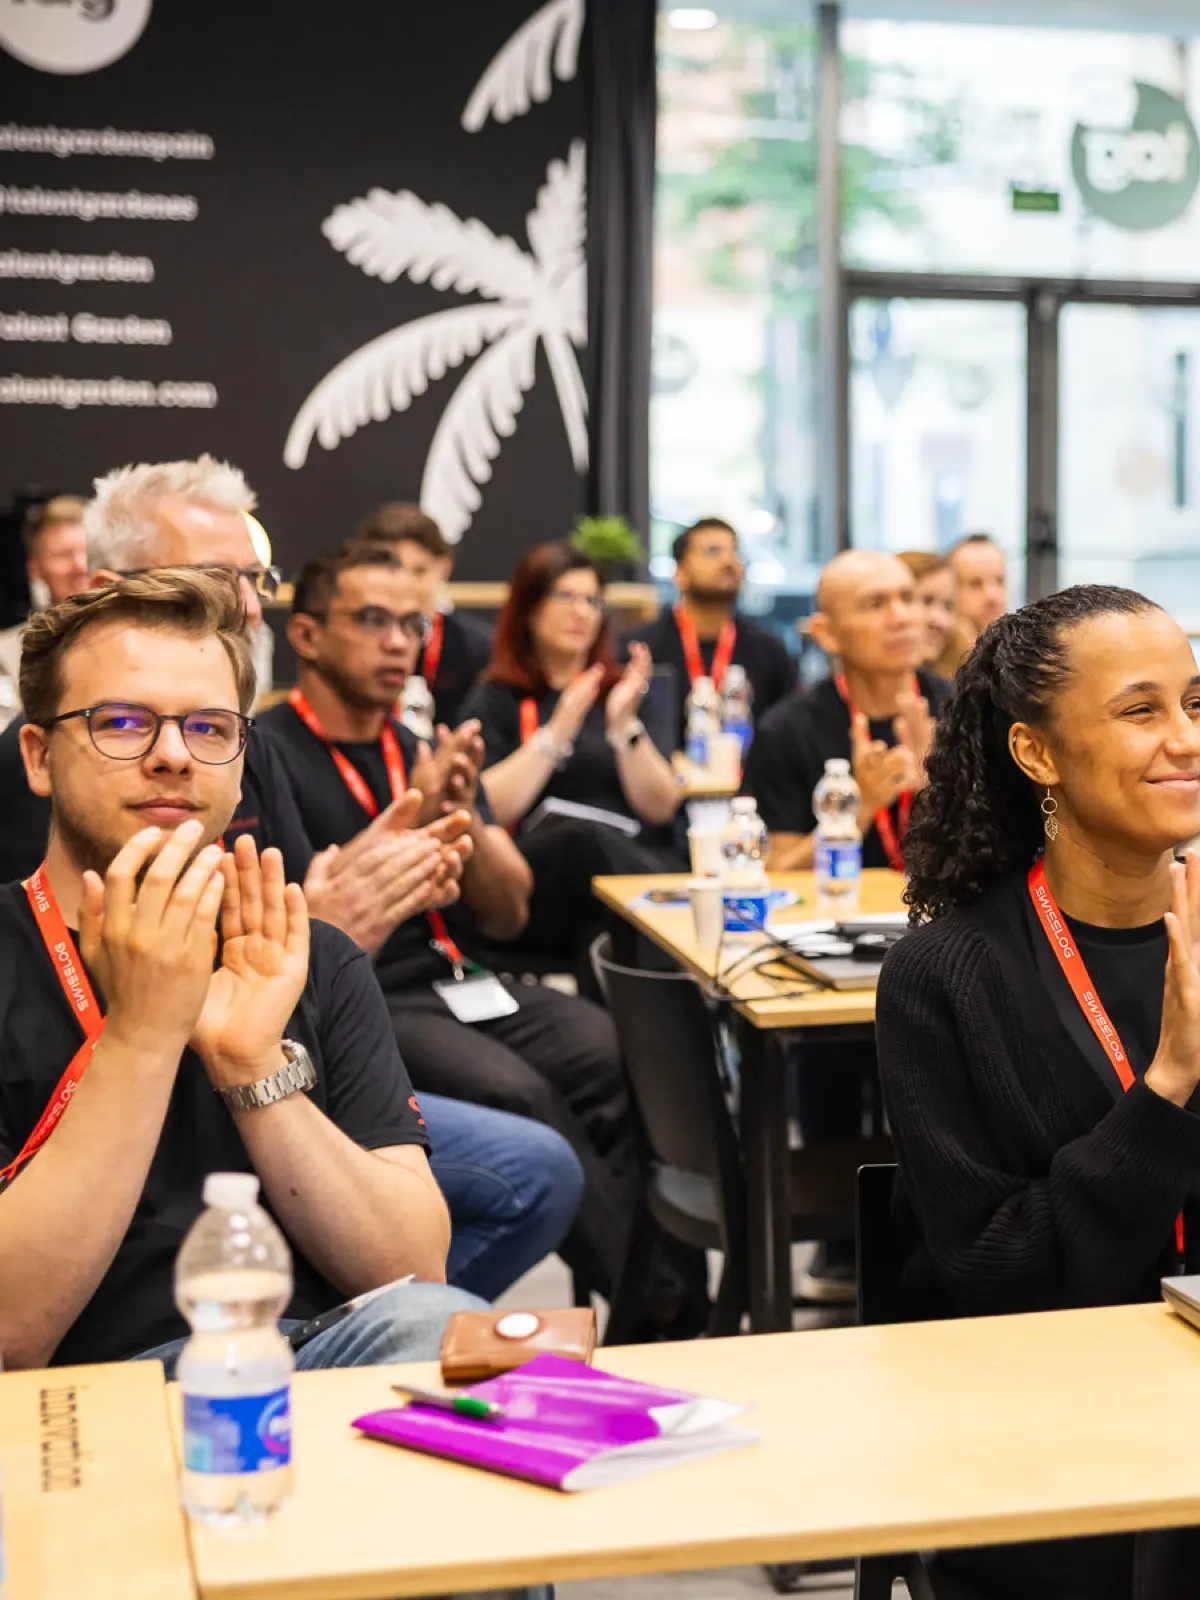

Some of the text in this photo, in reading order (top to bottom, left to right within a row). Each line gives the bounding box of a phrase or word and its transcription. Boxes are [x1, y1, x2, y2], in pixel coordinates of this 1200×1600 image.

[0, 311, 173, 345] alent Garden
[1035, 885, 1075, 959] SWISSLOG
[54, 942, 89, 1012] SWISSLOG
[1083, 991, 1125, 1062] SWISSLOG
